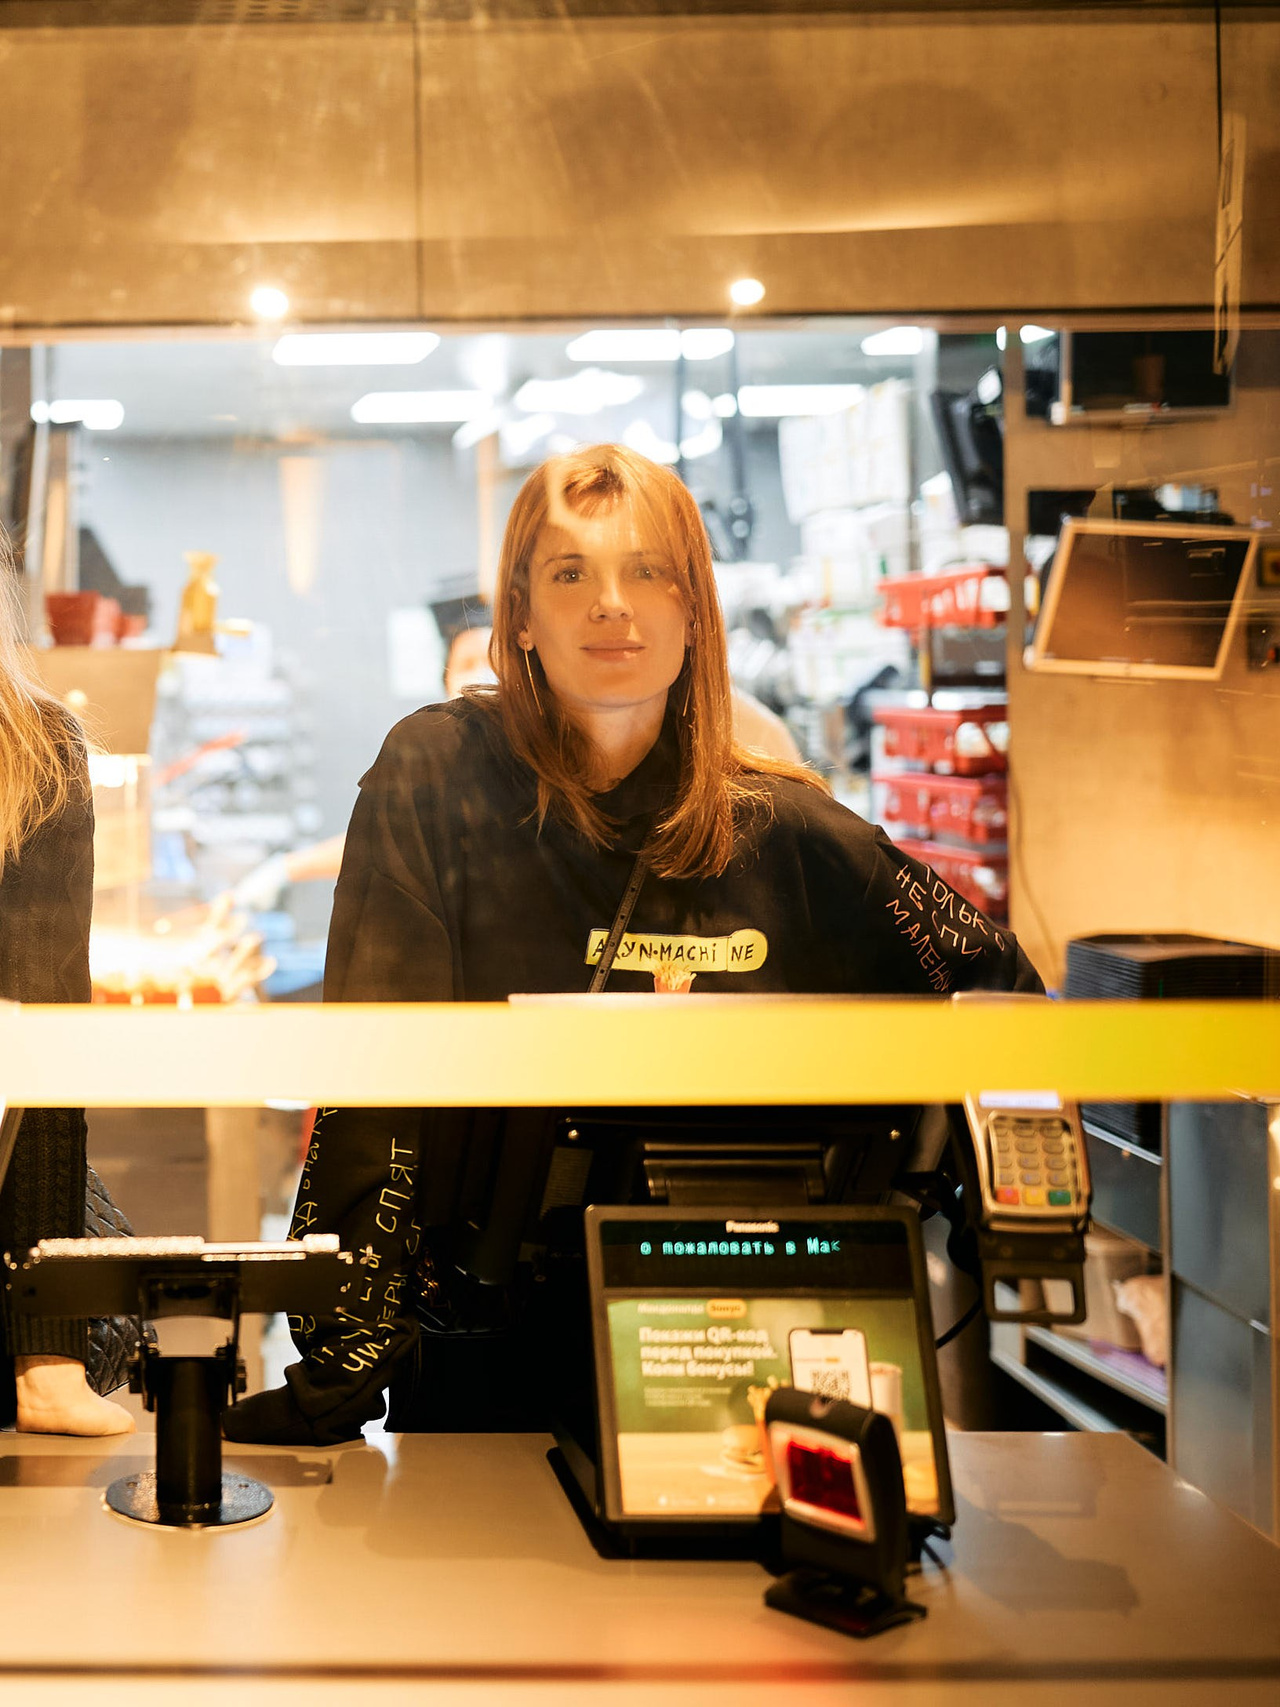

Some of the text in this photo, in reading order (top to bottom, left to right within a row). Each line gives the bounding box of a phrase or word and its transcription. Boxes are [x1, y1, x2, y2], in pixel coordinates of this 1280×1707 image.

[895, 864, 925, 912] НЕ
[376, 1137, 414, 1234] СПЯТ
[640, 1241, 652, 1256] о
[662, 1241, 775, 1256] пожаловать
[785, 1241, 797, 1256] в
